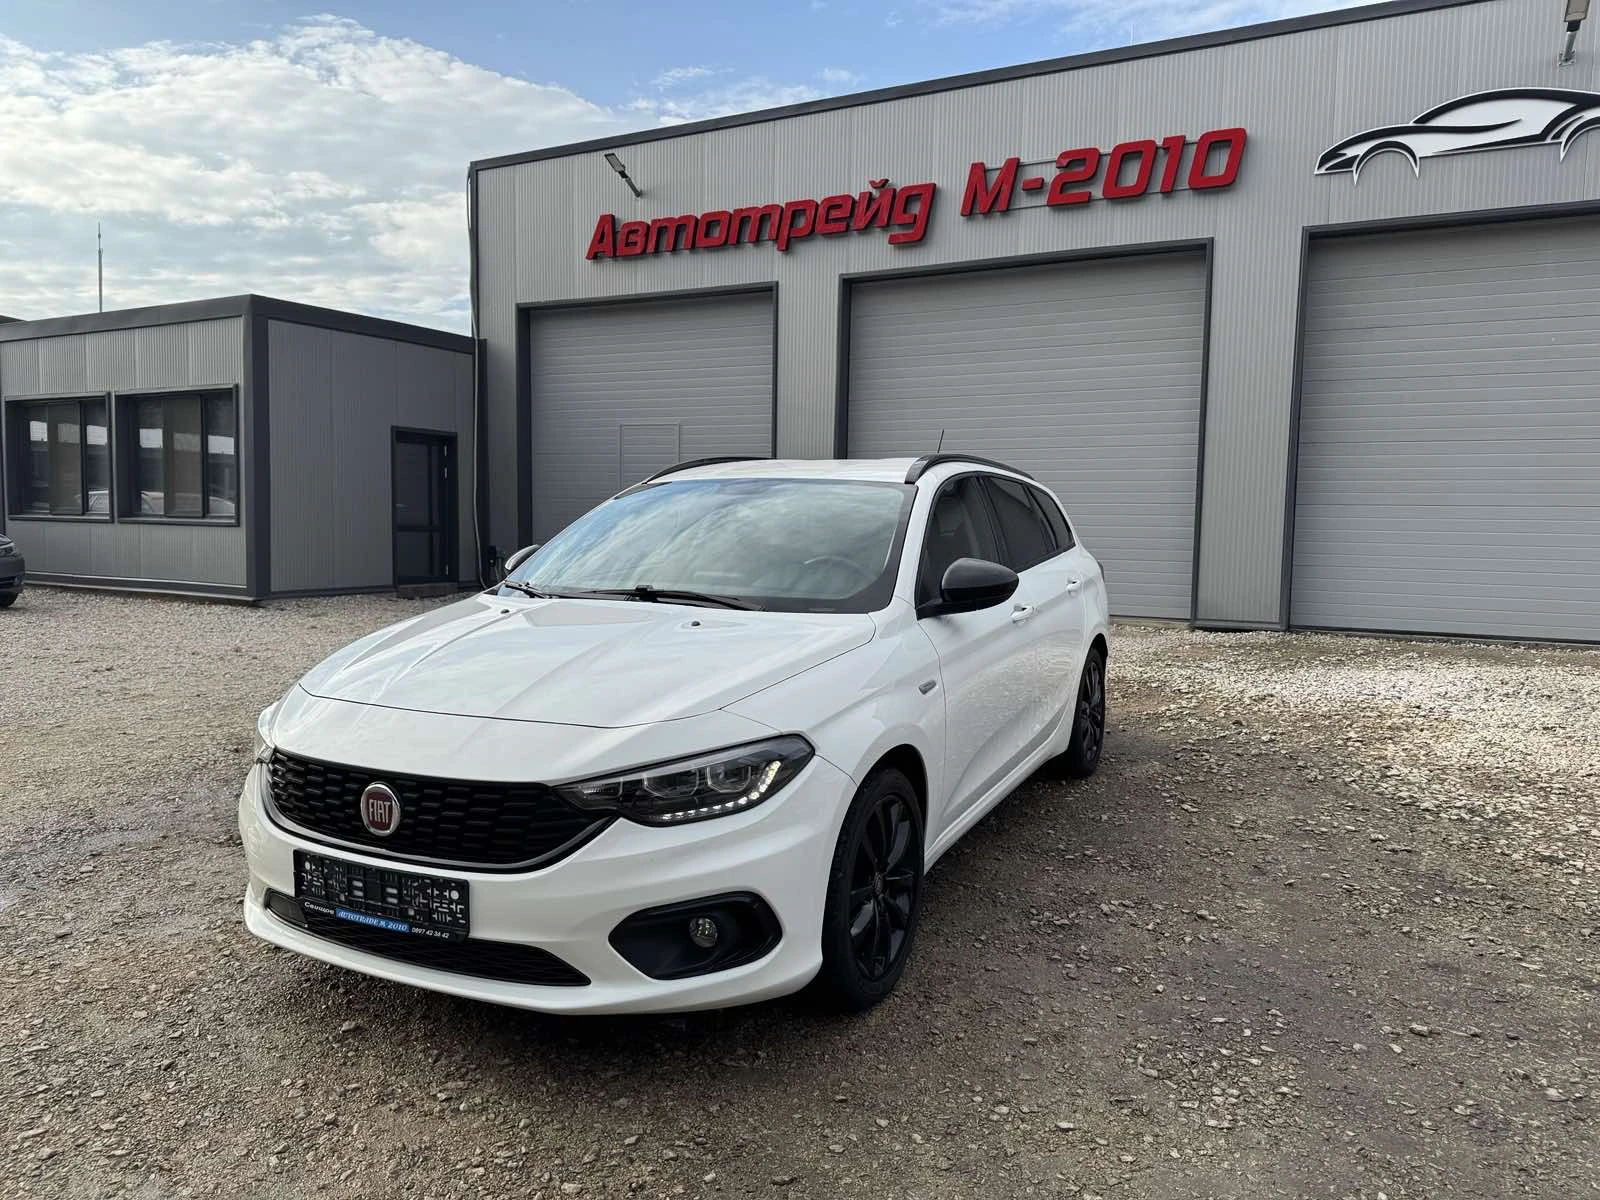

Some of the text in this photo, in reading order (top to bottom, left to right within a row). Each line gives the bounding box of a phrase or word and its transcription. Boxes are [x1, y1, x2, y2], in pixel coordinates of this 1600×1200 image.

[585, 127, 1247, 260] Автотрейд М-2010
[368, 799, 391, 824] FIAT
[338, 911, 379, 926] AUTOTRADE
